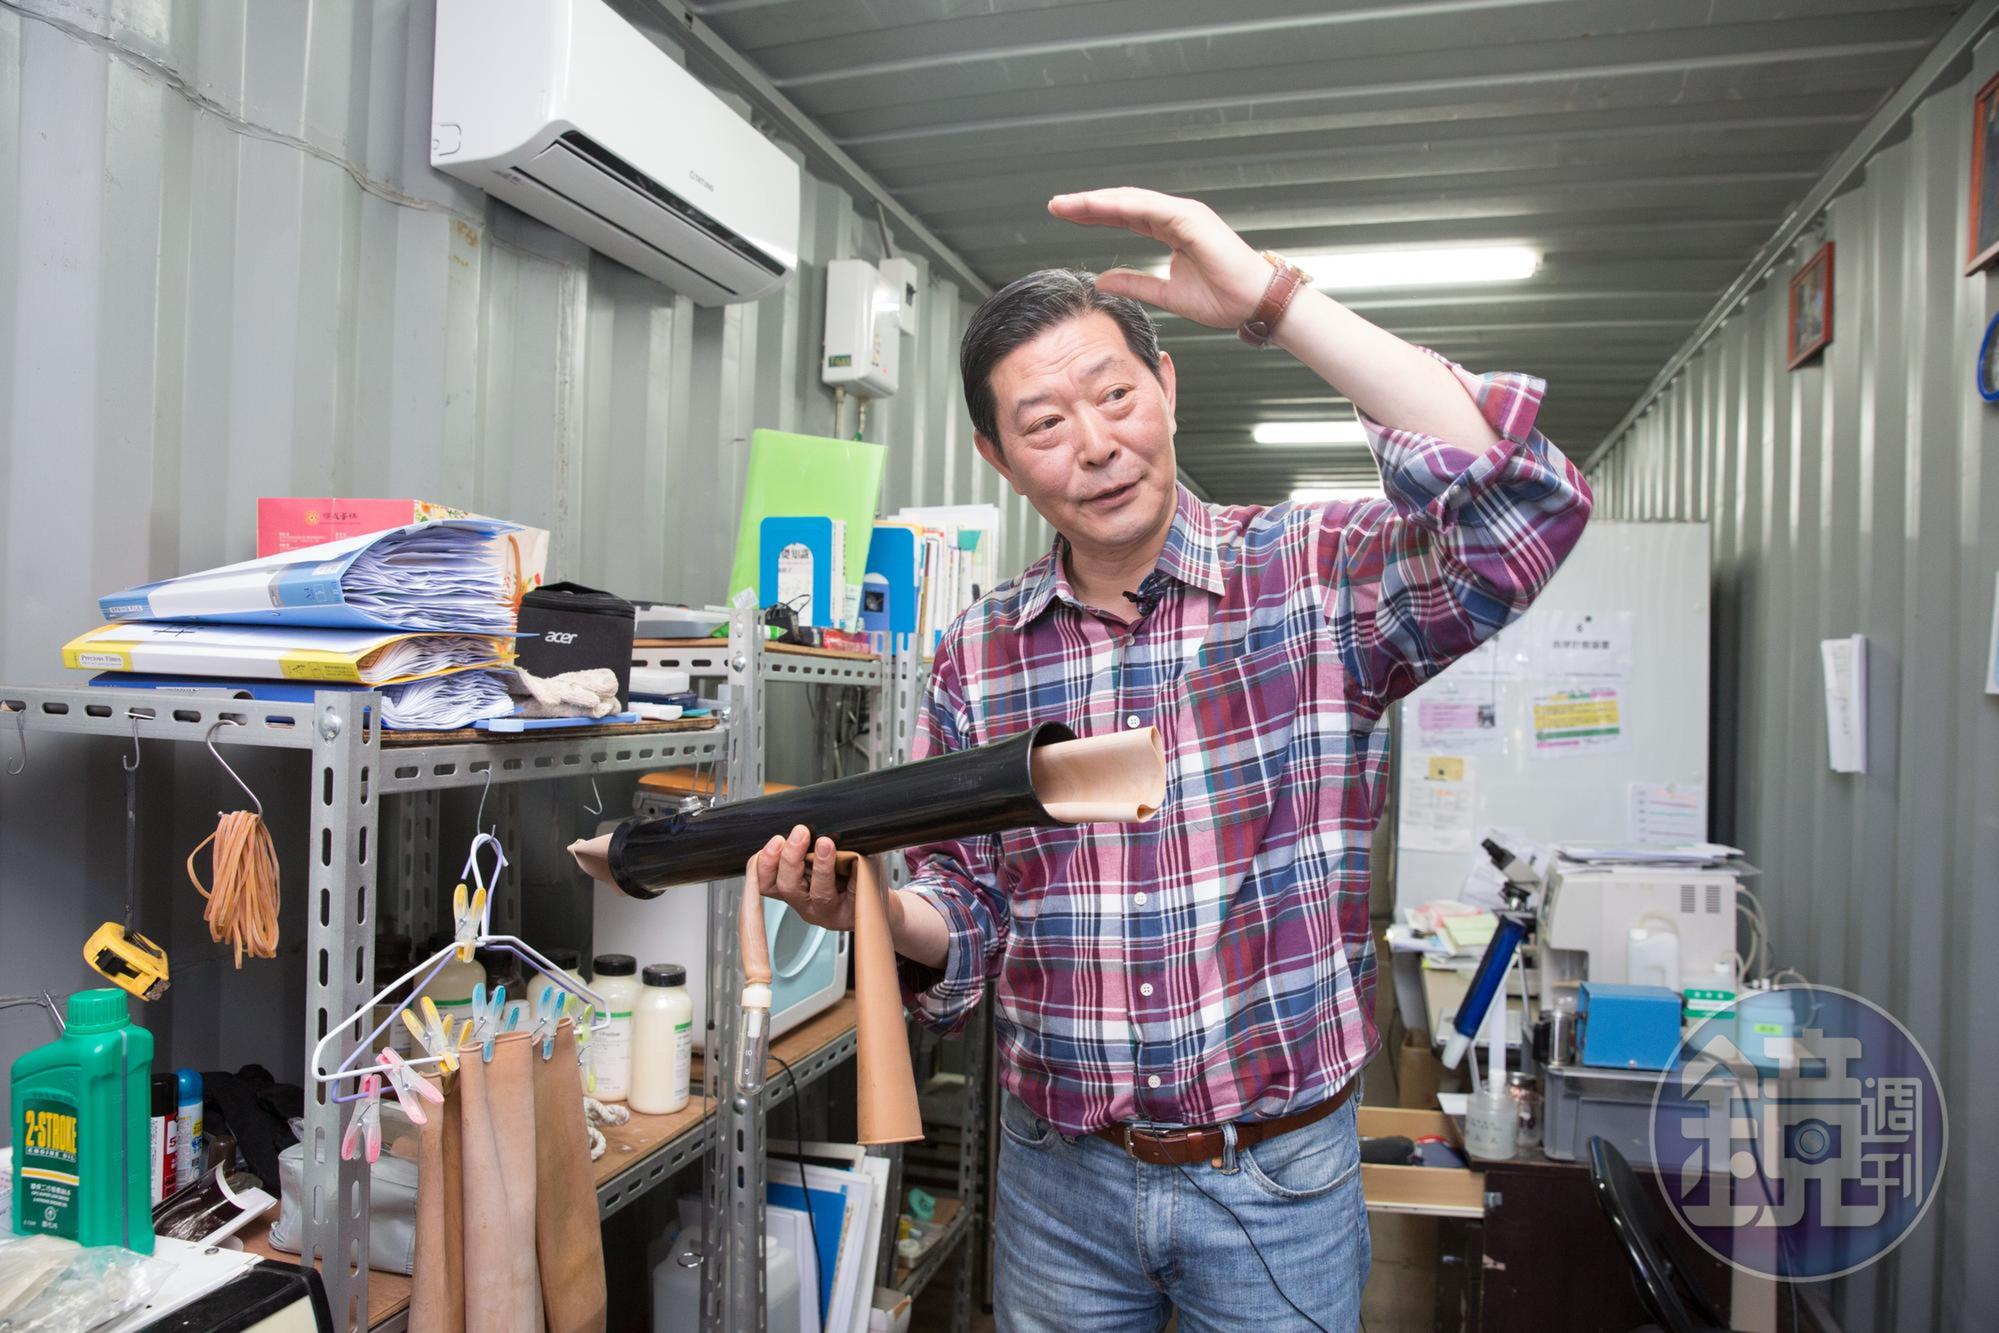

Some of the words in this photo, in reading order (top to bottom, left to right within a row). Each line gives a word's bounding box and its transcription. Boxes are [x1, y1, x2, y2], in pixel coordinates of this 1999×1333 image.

[545, 631, 578, 645] acer
[81, 654, 104, 662] Precious
[25, 1109, 77, 1154] 2-STROKE
[27, 1147, 60, 1157] ENGINE
[62, 1152, 76, 1161] OIL
